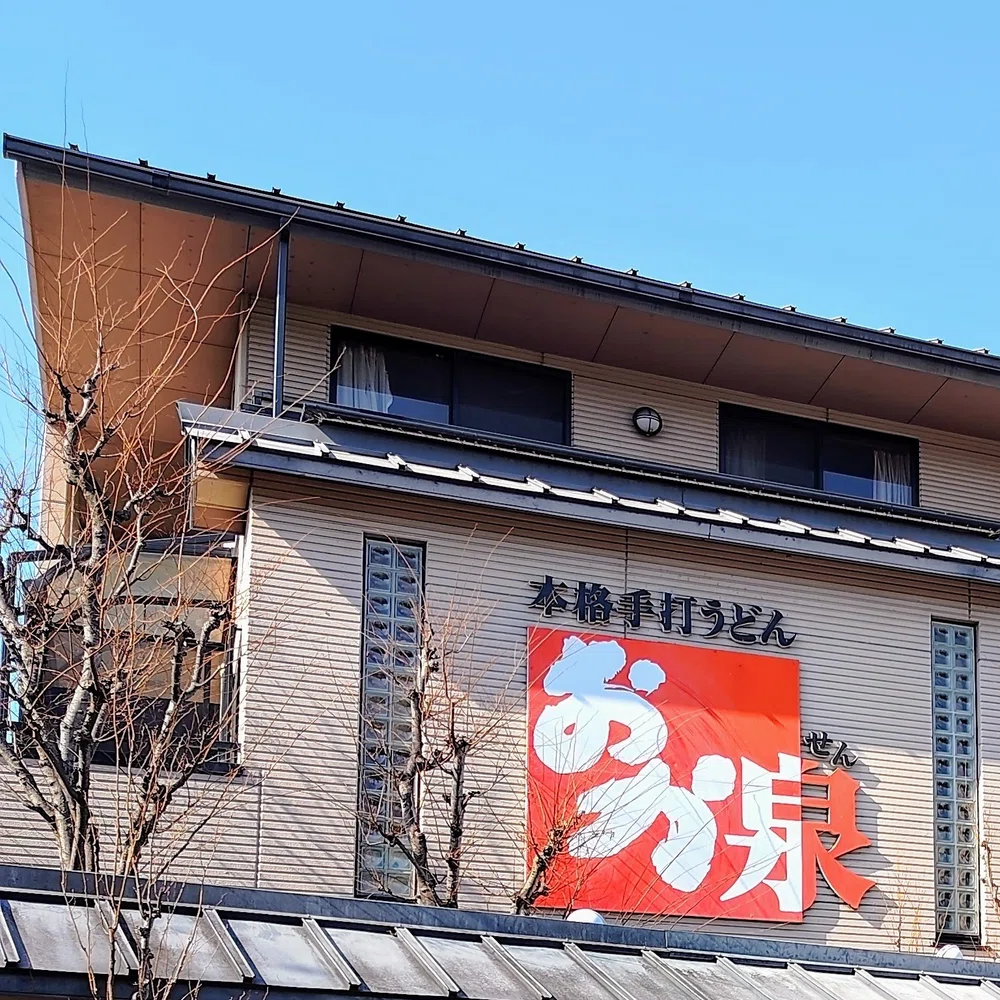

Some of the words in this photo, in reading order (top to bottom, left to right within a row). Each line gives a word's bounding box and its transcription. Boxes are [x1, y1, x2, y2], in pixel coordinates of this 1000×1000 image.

[527, 574, 798, 649] 本格手打うどん
[533, 635, 876, 913] おか泉
[803, 730, 859, 769] せん
